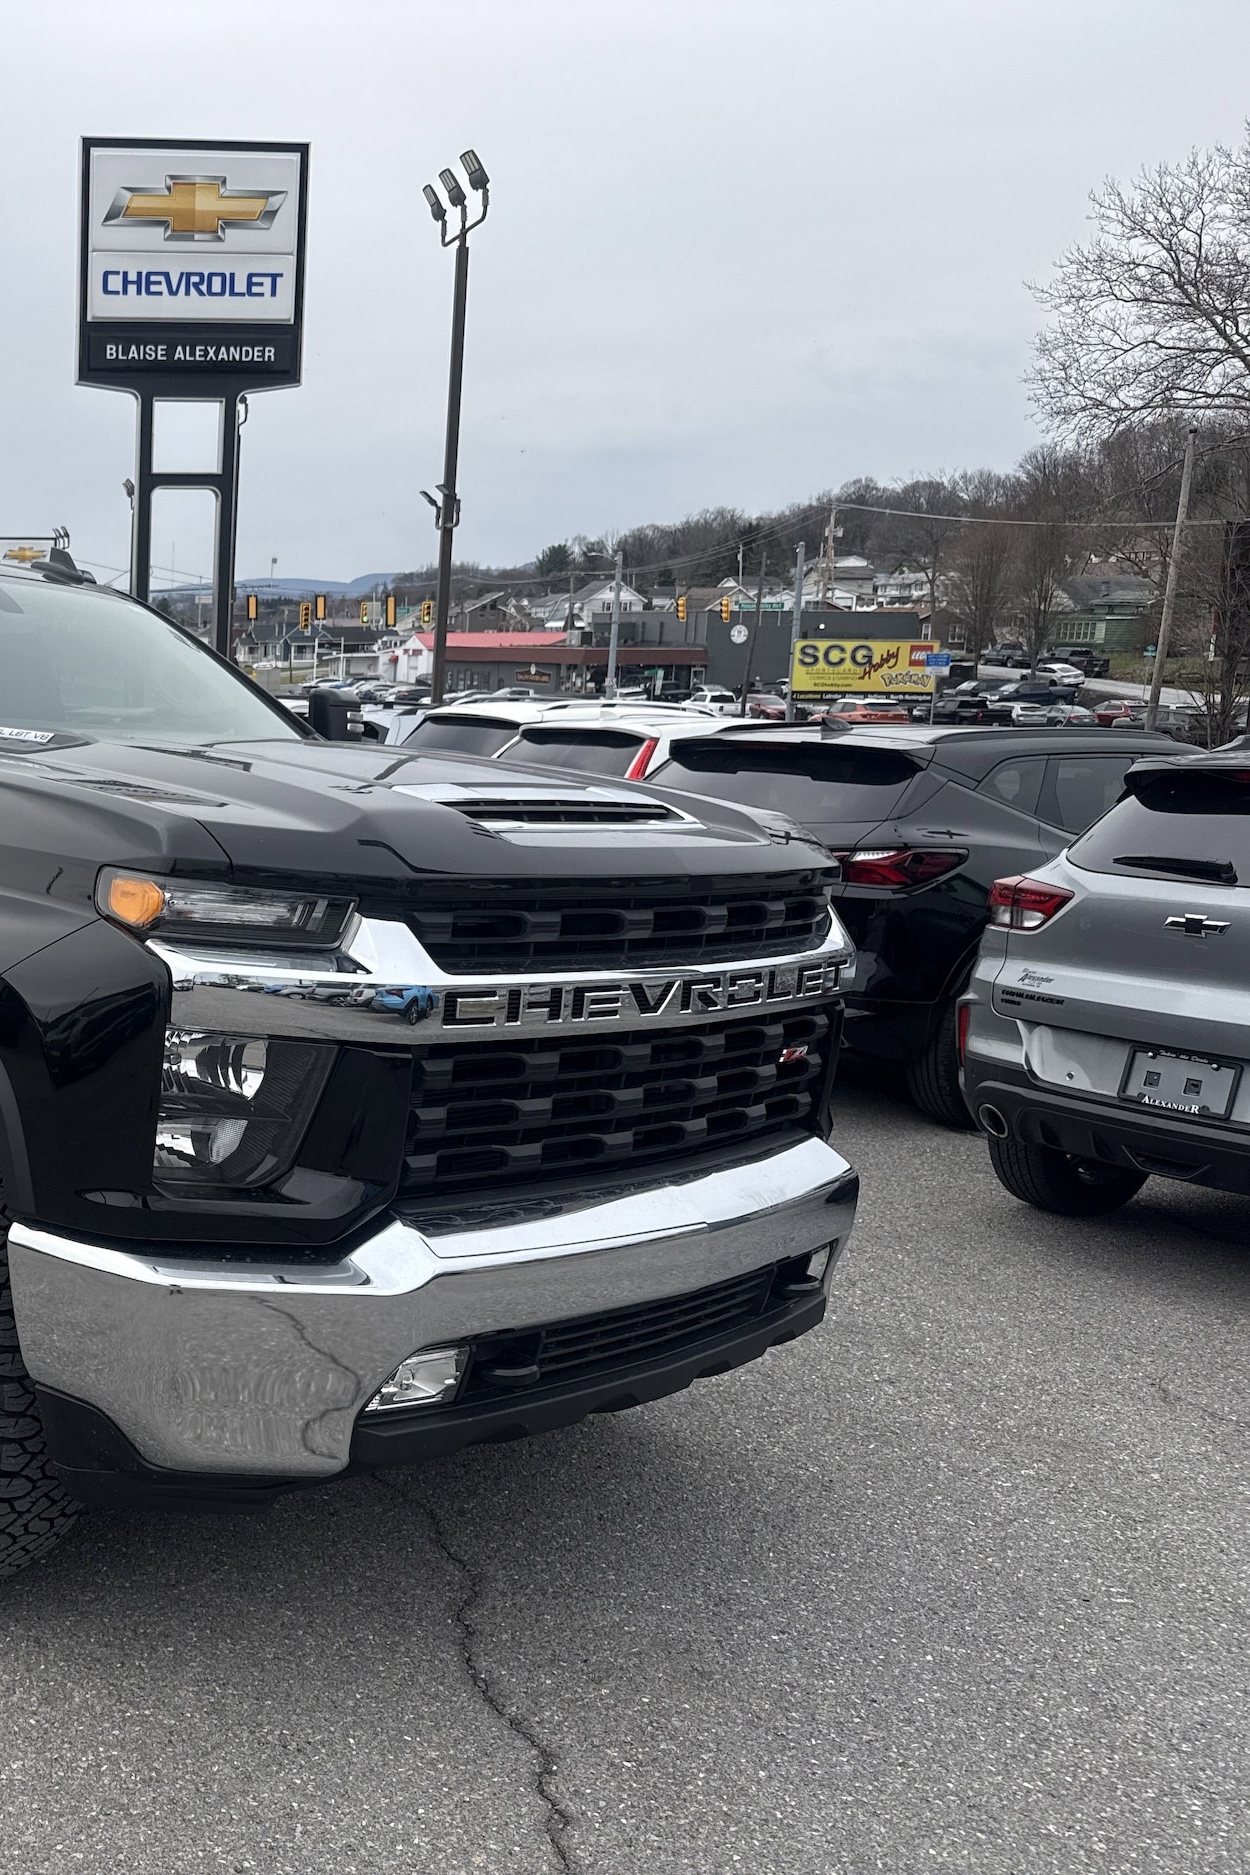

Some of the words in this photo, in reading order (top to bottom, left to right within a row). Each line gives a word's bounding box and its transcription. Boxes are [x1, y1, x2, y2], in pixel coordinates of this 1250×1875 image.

[102, 270, 284, 298] CHEVROLET
[106, 344, 167, 360] BLAISE
[174, 345, 276, 362] ALEXANDER
[798, 643, 874, 668] SCG
[857, 646, 900, 681] Hobby
[911, 651, 927, 660] LEG
[442, 959, 850, 1028] CHEVROLET
[1141, 1095, 1200, 1114] ALEXANDER
